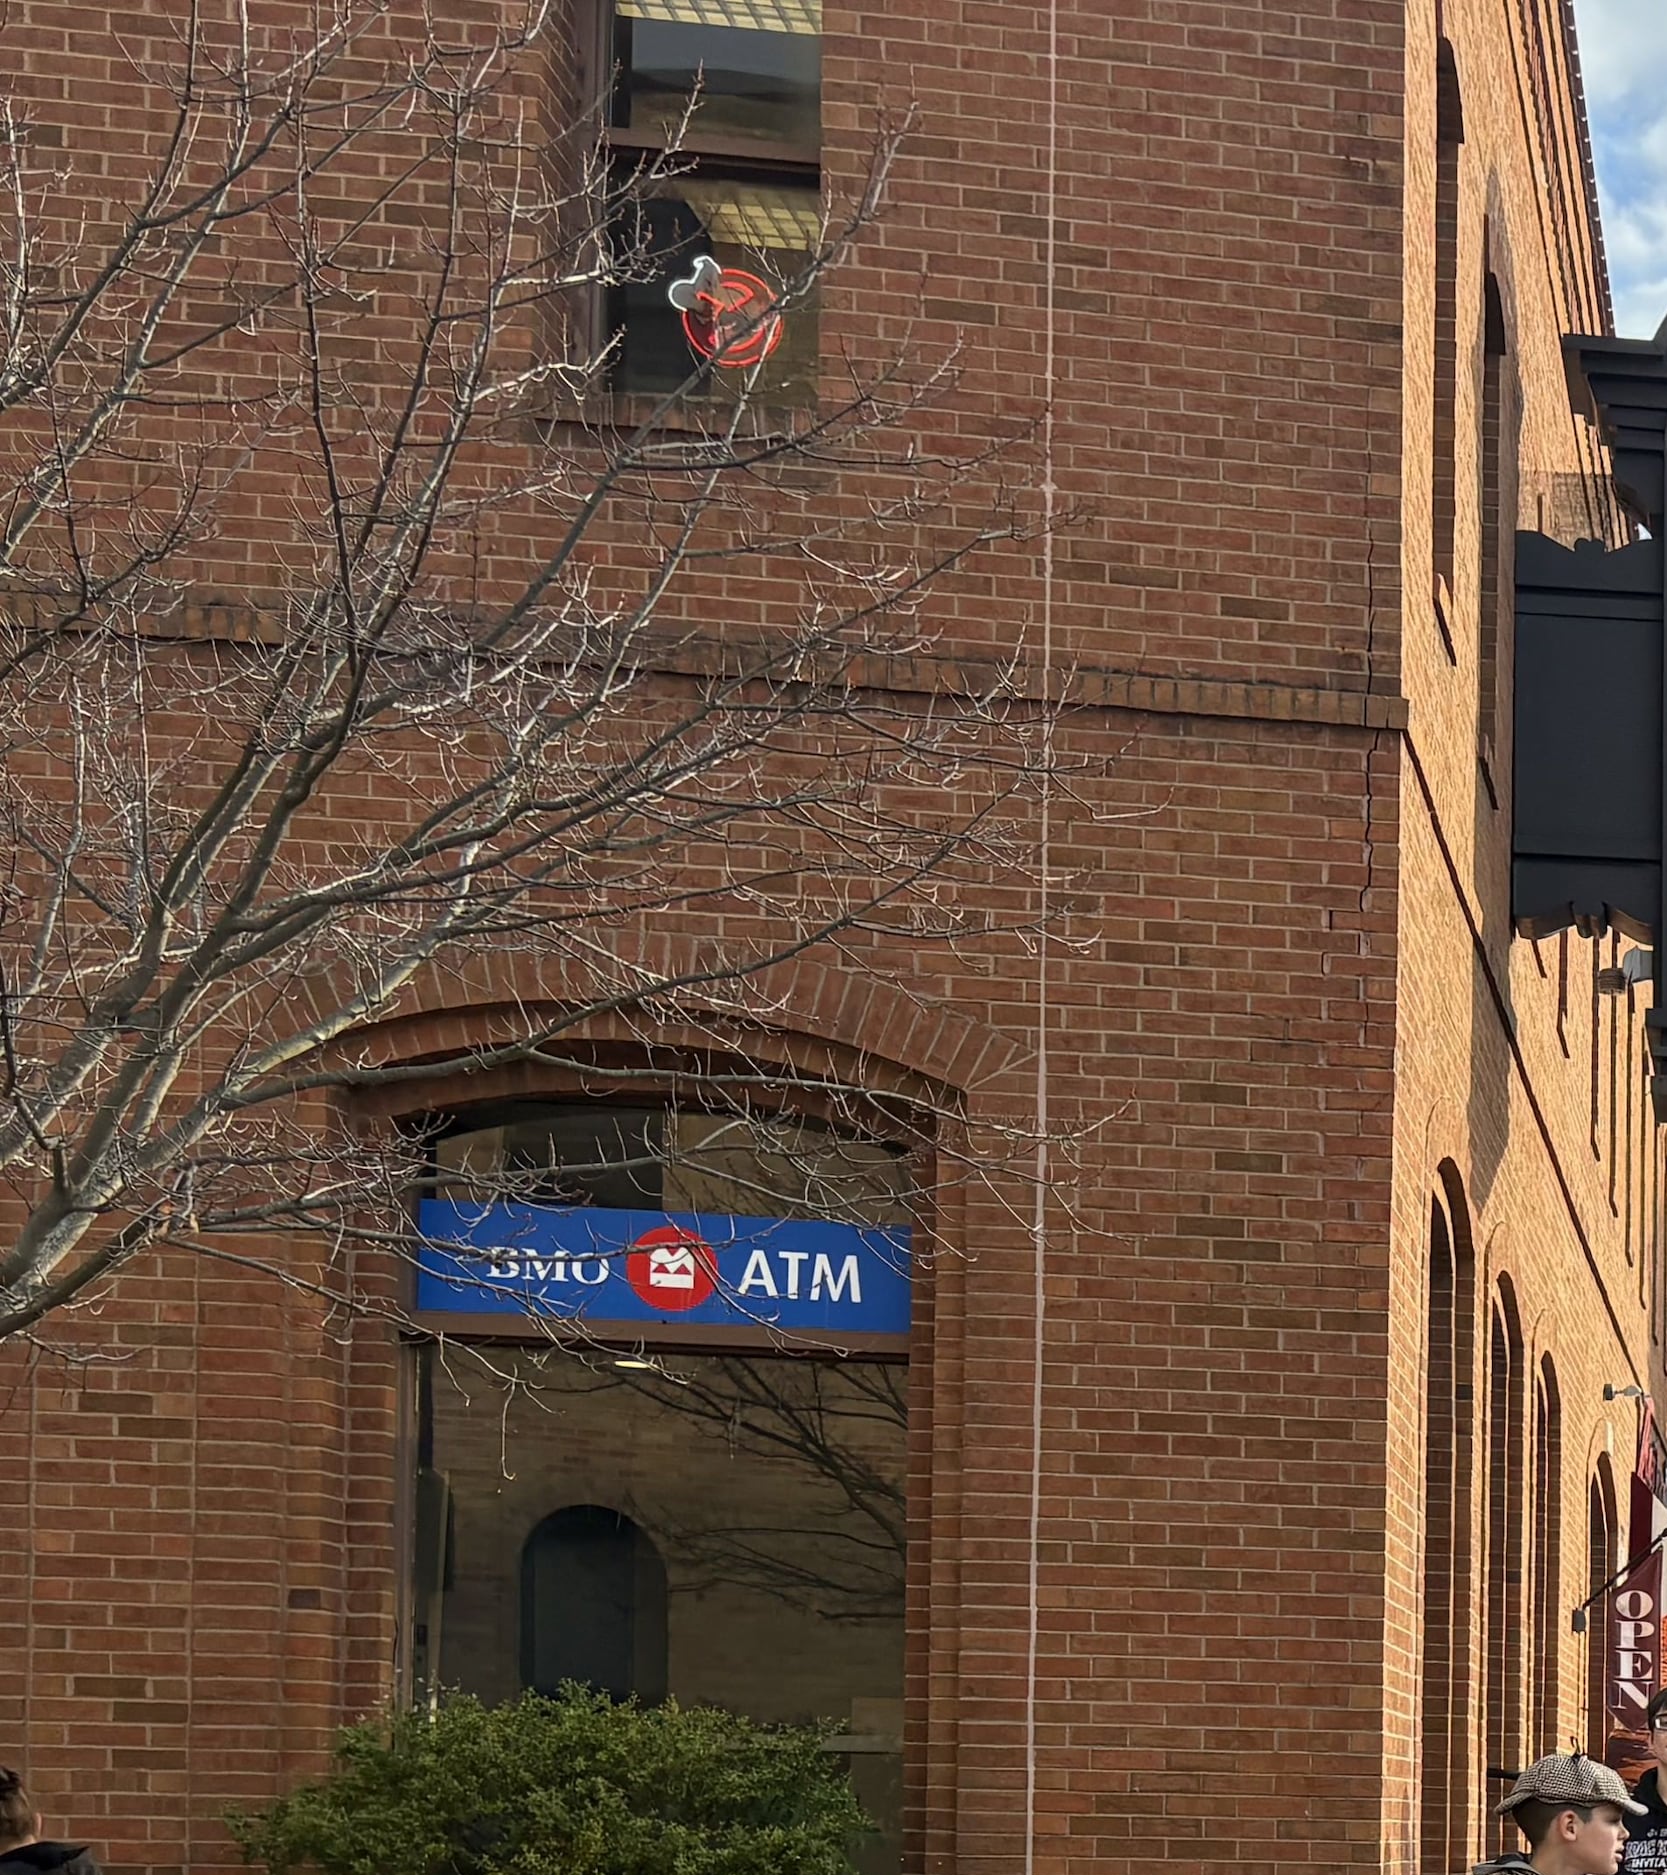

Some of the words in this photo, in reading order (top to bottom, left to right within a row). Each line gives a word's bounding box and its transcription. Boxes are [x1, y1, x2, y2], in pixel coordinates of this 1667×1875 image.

[485, 1243, 610, 1285] BMO
[737, 1249, 863, 1304] ATM
[1611, 1589, 1655, 1709] OPEN
